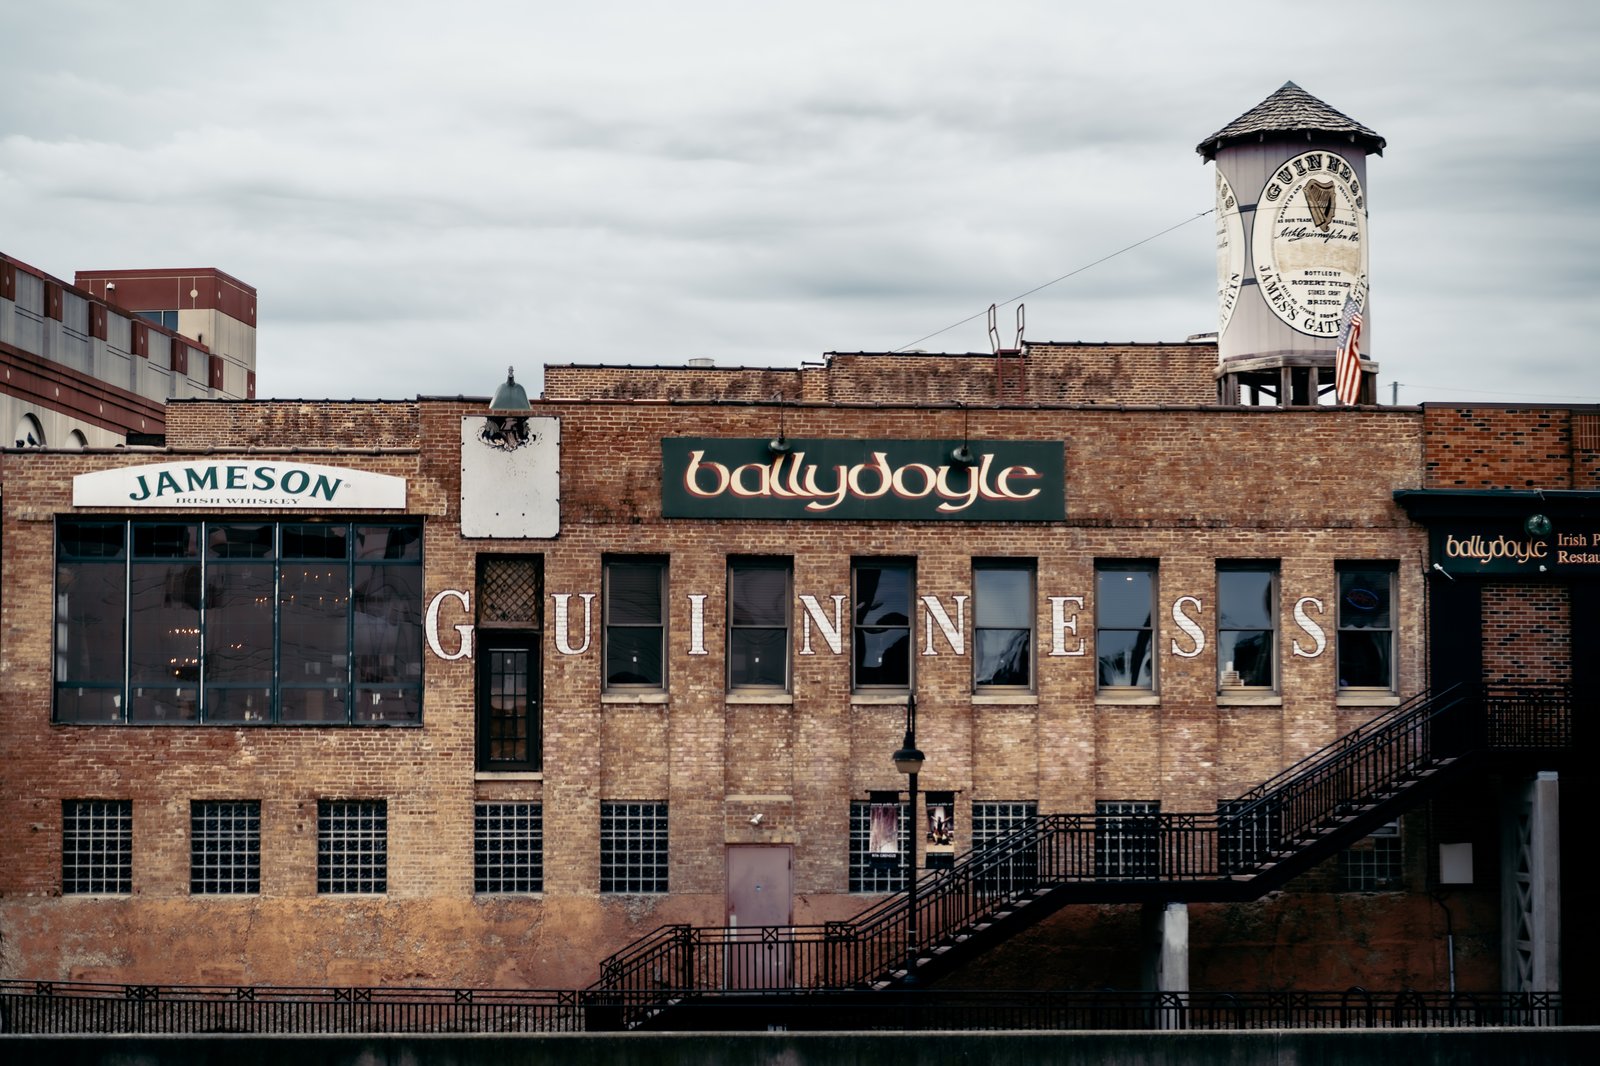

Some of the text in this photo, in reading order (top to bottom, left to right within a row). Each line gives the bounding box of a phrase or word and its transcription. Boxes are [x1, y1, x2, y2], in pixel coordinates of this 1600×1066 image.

[1266, 154, 1364, 210] GUINNESS
[129, 465, 343, 501] JAMESON
[683, 449, 1044, 513] ballydoyle
[226, 497, 302, 505] WHISKEY
[1445, 534, 1548, 564] ballydoyle
[1557, 532, 1588, 547] Irish
